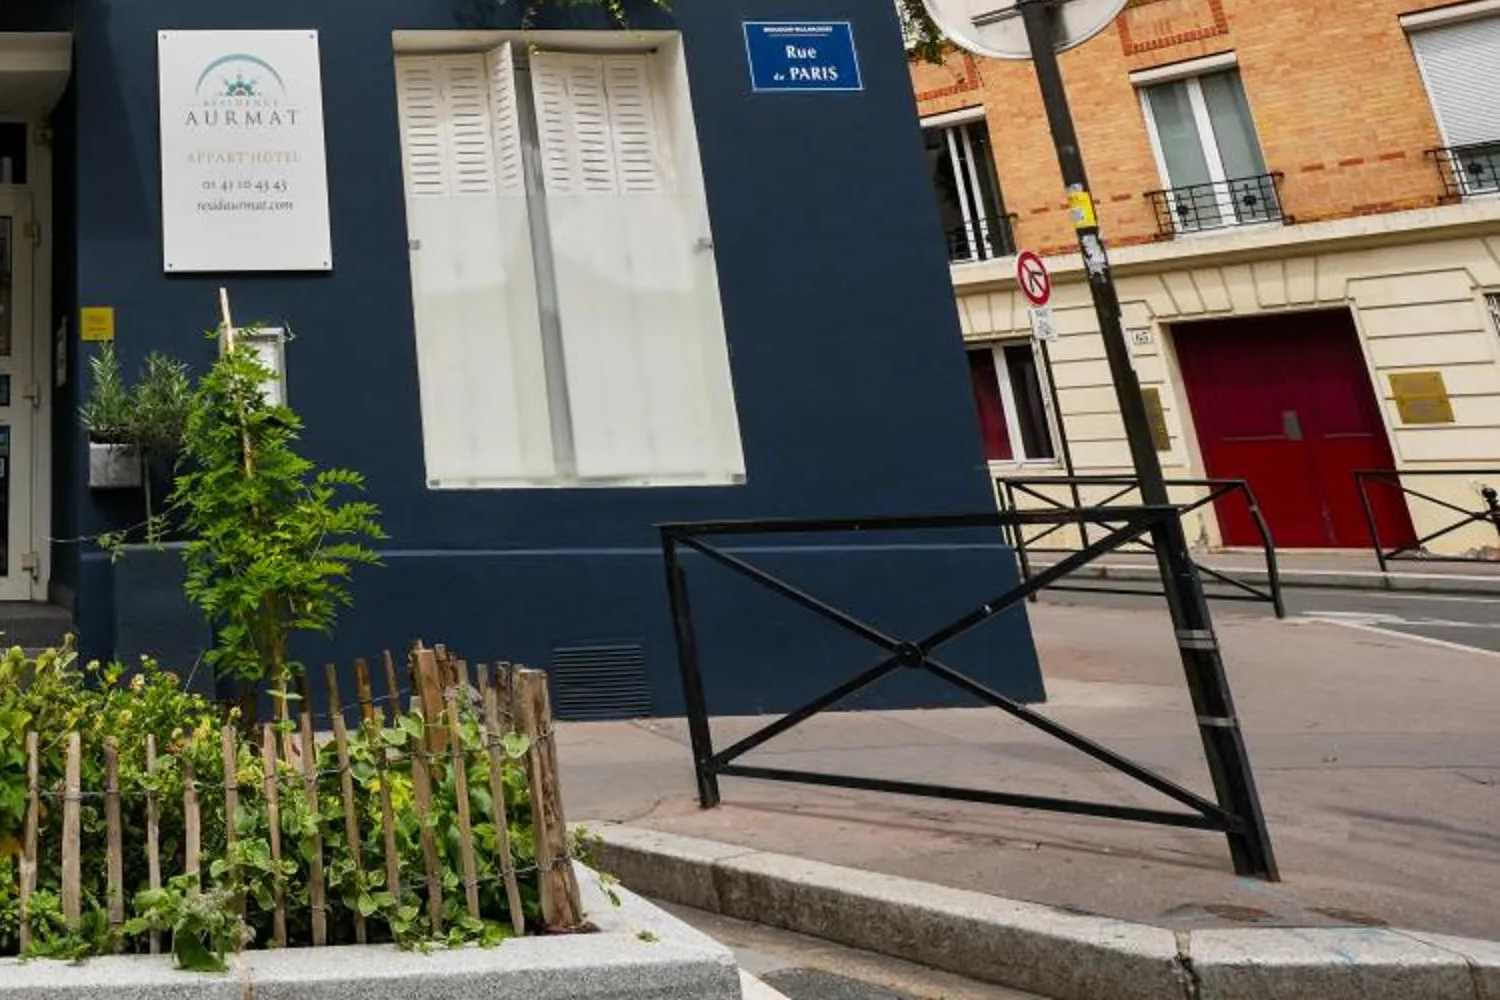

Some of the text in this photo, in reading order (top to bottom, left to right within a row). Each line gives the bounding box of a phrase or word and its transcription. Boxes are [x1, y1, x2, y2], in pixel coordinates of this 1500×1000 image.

[786, 44, 817, 59] Rue
[790, 66, 838, 81] PARIS
[186, 110, 300, 126] AURMAT
